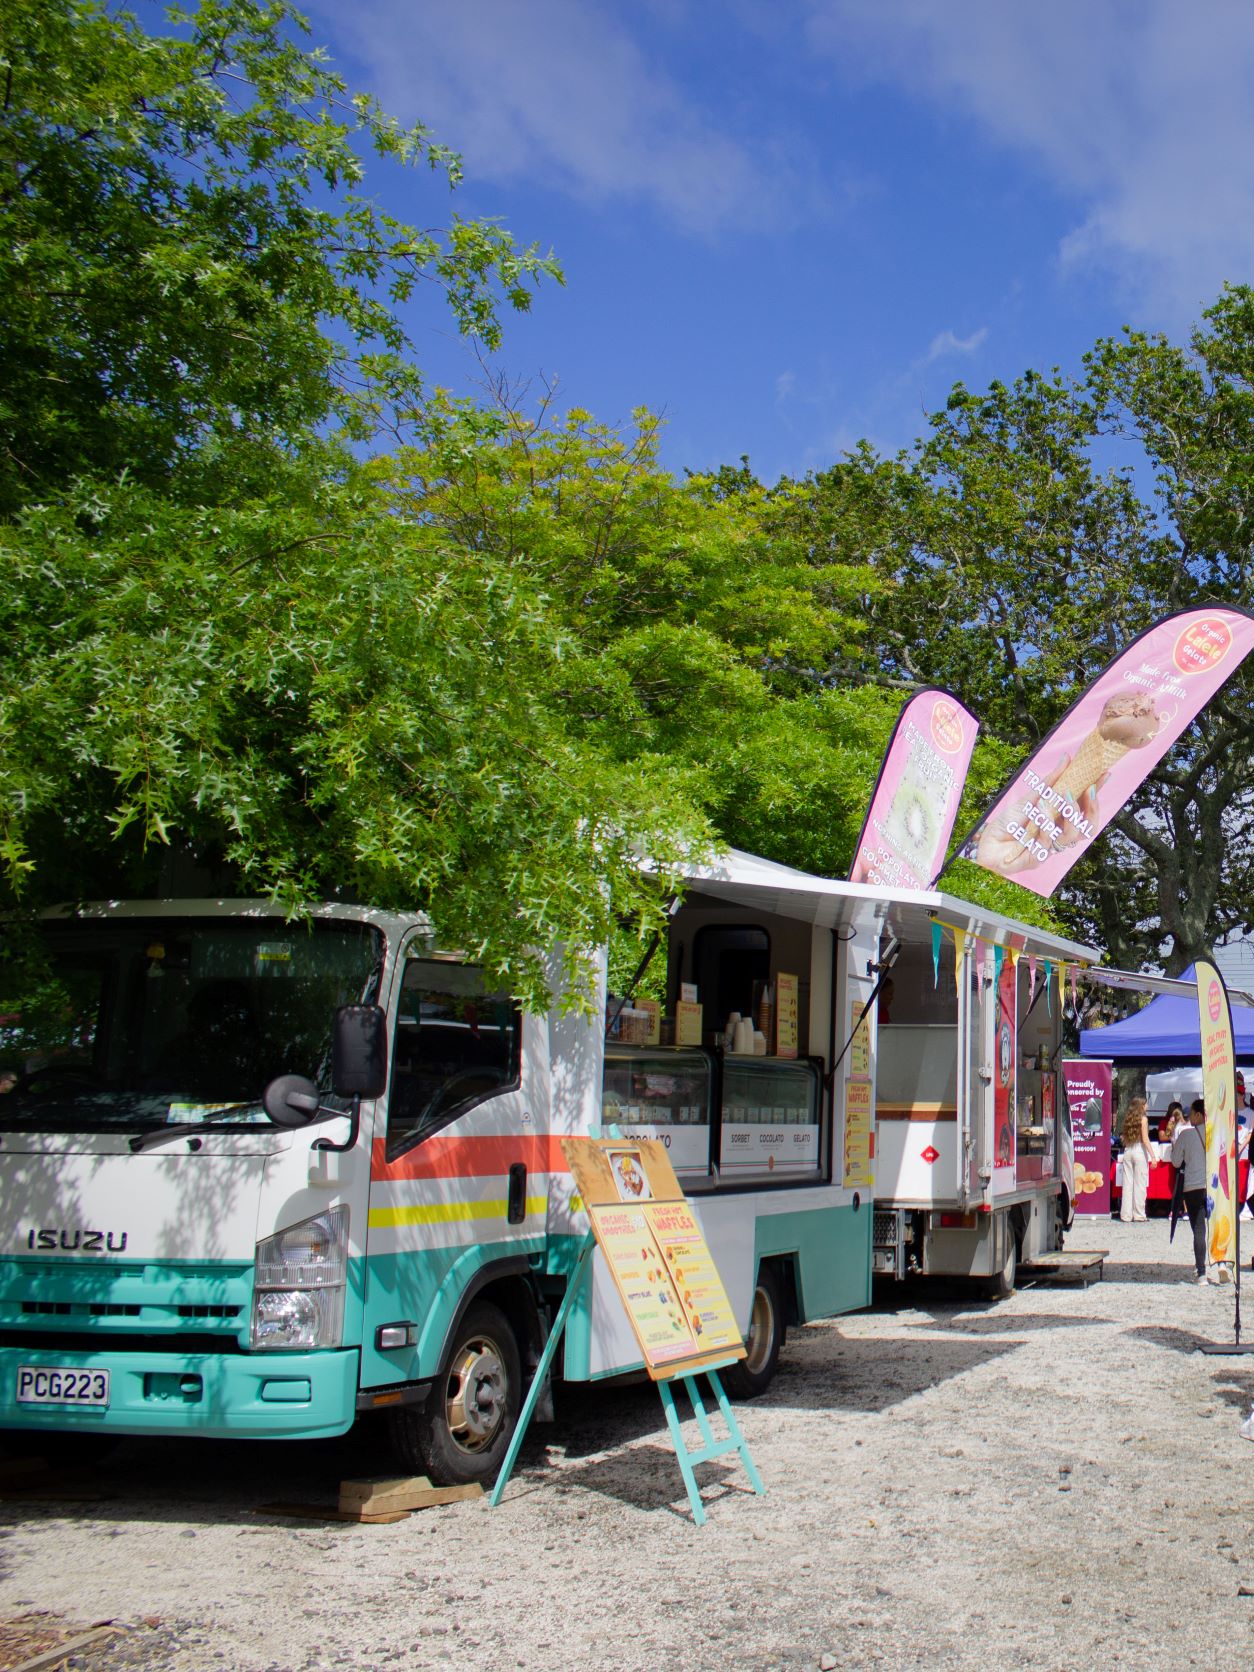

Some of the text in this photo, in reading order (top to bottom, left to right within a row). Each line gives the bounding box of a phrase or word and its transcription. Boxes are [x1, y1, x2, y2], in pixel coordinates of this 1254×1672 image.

[1201, 624, 1225, 643] Organic
[1183, 645, 1207, 664] Gelato
[1123, 670, 1156, 690] Organic
[1139, 663, 1161, 678] Made
[908, 721, 954, 776] MADE FROM
[914, 756, 937, 782] FRUIT
[1023, 770, 1095, 839] TRADITIONAL
[1022, 801, 1063, 841] RECIPE
[872, 819, 902, 851] NOTHING
[1006, 821, 1048, 862] GELATO
[877, 847, 921, 890] POPOLATO
[1067, 1080, 1095, 1089] Proudly
[1095, 1088, 1105, 1097] by
[731, 1133, 811, 1144] SORBET COCOLATO GELATO
[653, 1216, 694, 1231] WAFFLES
[27, 1229, 128, 1252] ISUZU
[20, 1371, 106, 1400] PCG223
